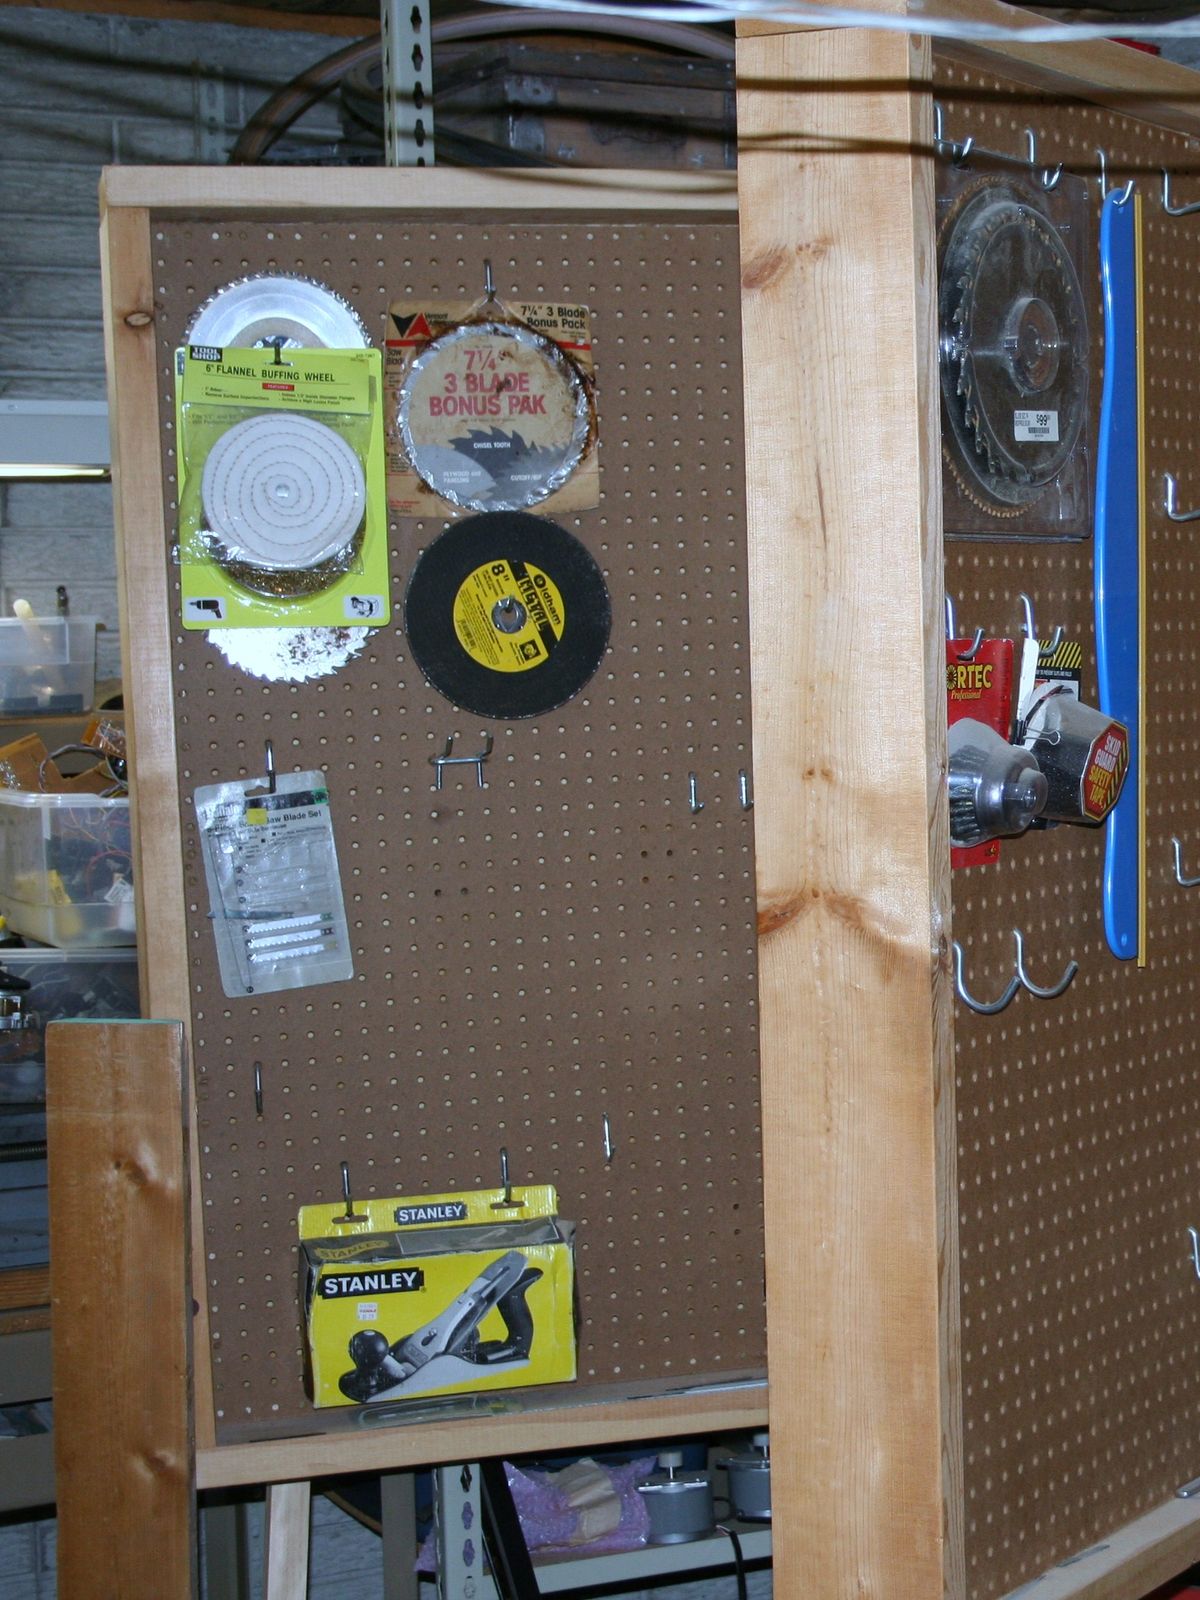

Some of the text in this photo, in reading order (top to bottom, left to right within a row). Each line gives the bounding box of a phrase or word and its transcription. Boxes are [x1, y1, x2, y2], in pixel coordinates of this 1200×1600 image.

[527, 317, 586, 330] Bonus Pack
[546, 305, 554, 317] 3
[557, 306, 586, 319] Blade
[191, 345, 221, 353] TOOL
[191, 352, 222, 361] SHOP
[205, 363, 336, 383] 6" FLANNEL BUFFING WHEEL
[443, 371, 530, 394] 3 BLADE
[429, 394, 548, 417] BONUS PAK
[517, 574, 549, 632] METAL
[533, 573, 562, 626] Oldham
[946, 664, 993, 690] ORTEC
[1104, 734, 1122, 757] SKID
[1094, 748, 1118, 773] GUARD
[1088, 764, 1113, 790] SAFETY
[283, 811, 307, 822] Blade
[308, 809, 322, 818] Set
[397, 1204, 465, 1223] STANLEY
[323, 1271, 418, 1295] STANLEY
